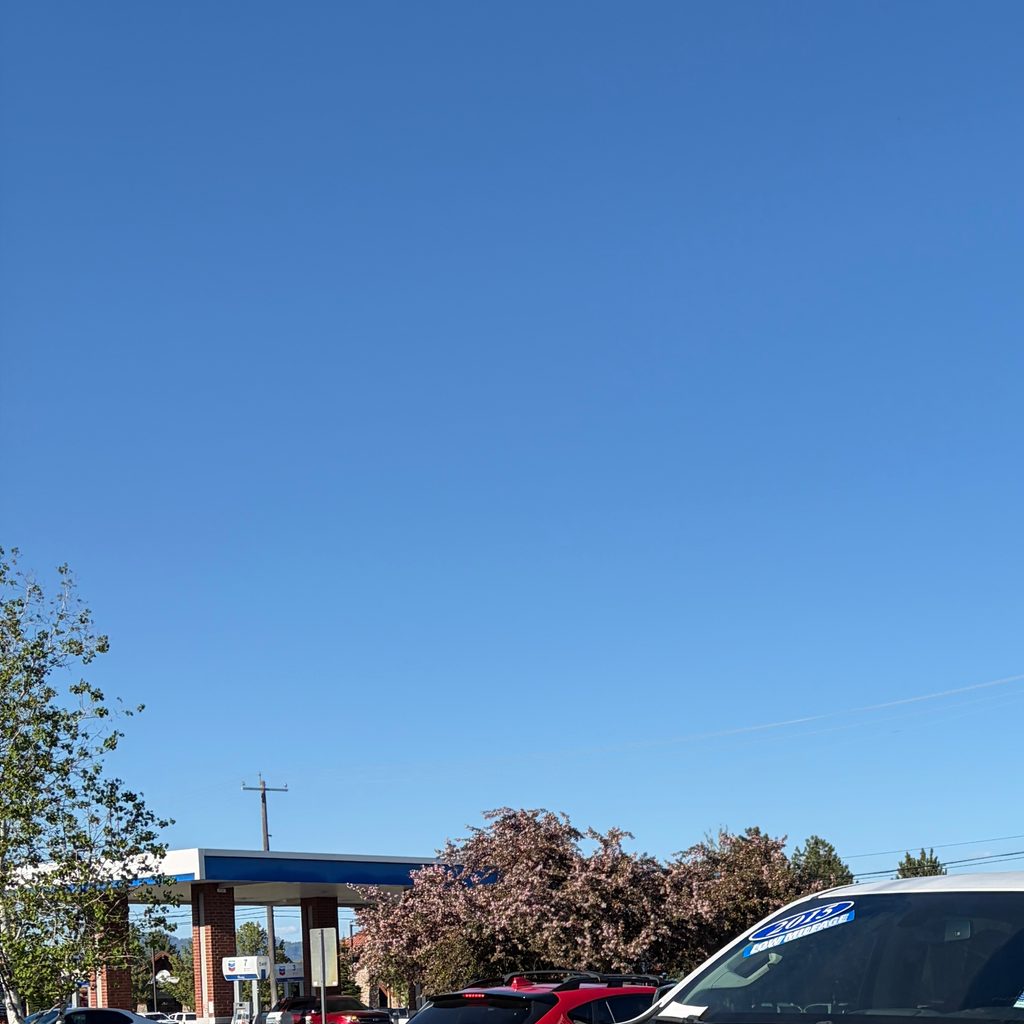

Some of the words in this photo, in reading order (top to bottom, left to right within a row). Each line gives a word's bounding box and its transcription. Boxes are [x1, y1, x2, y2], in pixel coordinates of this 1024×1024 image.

[749, 935, 785, 956] LOW
[783, 913, 850, 943] MILEAGE
[765, 903, 840, 937] 2015
